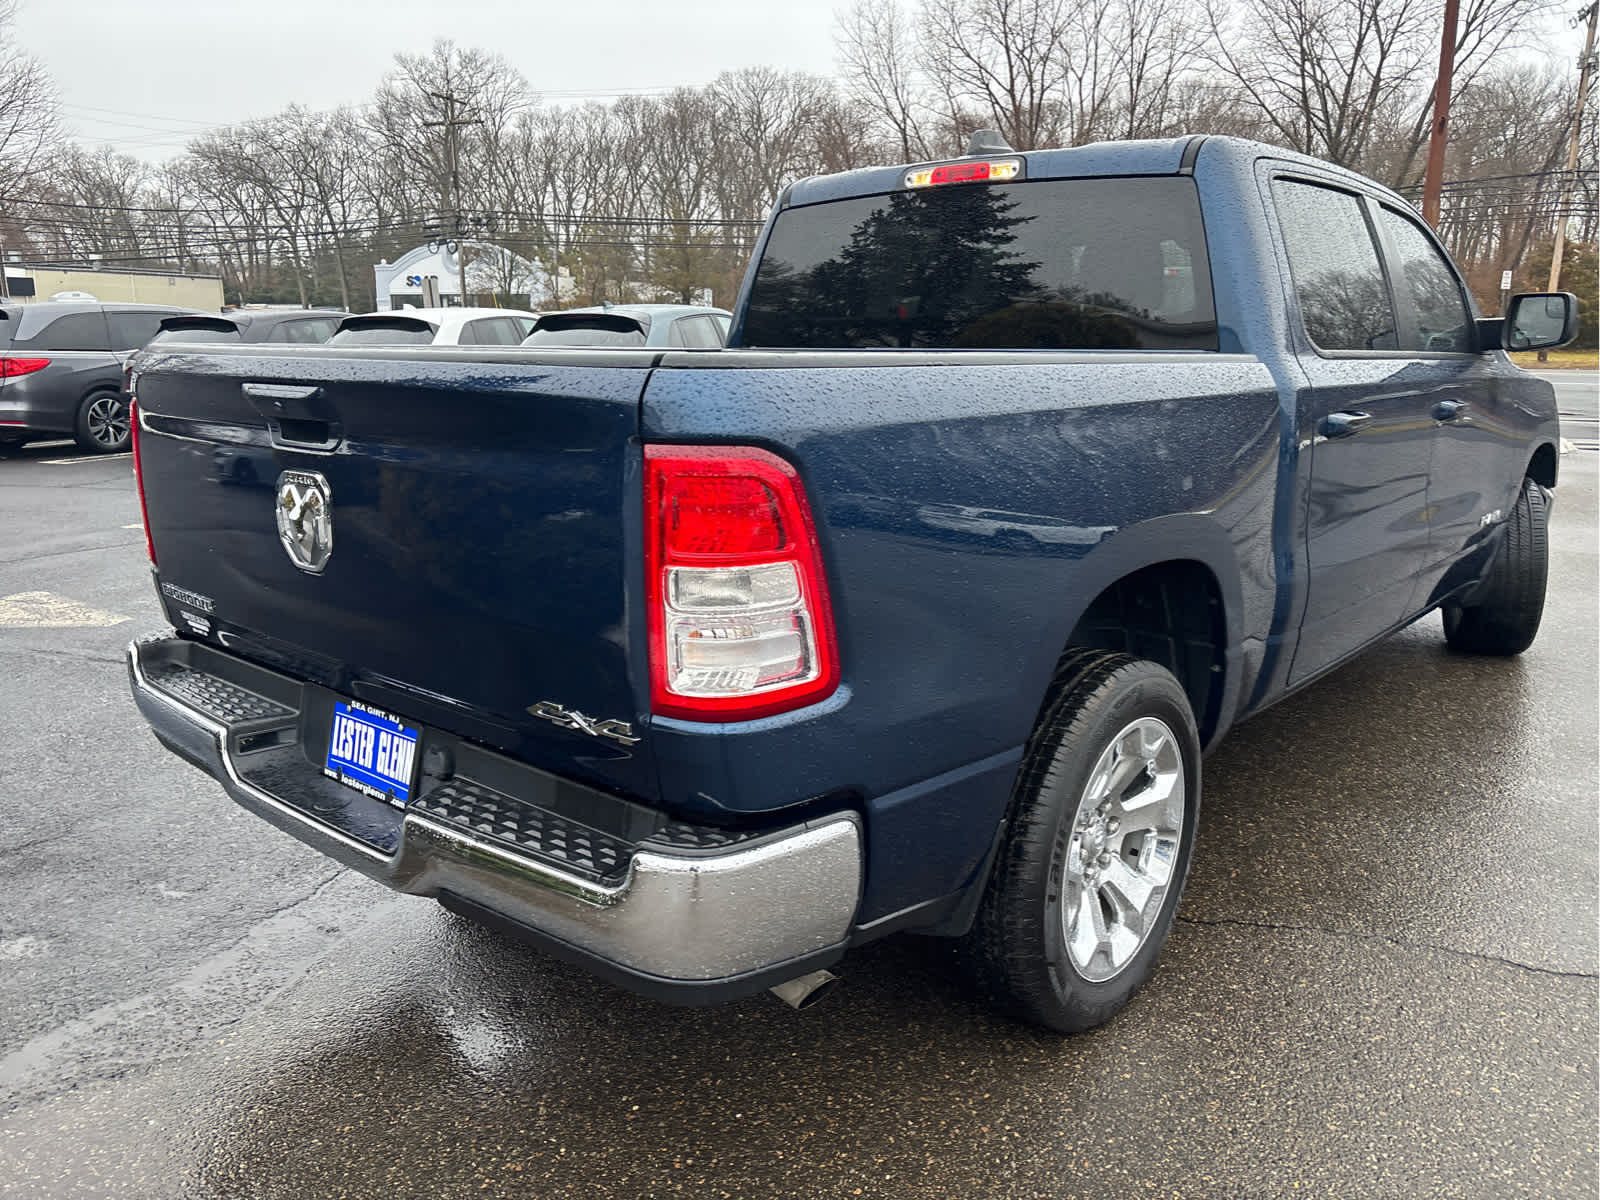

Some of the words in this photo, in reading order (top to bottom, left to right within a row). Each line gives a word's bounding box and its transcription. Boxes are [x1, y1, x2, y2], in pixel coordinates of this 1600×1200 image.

[406, 275, 438, 287] SO
[351, 700, 367, 712] SEA
[388, 713, 400, 724] NJ
[331, 715, 375, 769] LESTER
[376, 731, 416, 785] GLENN
